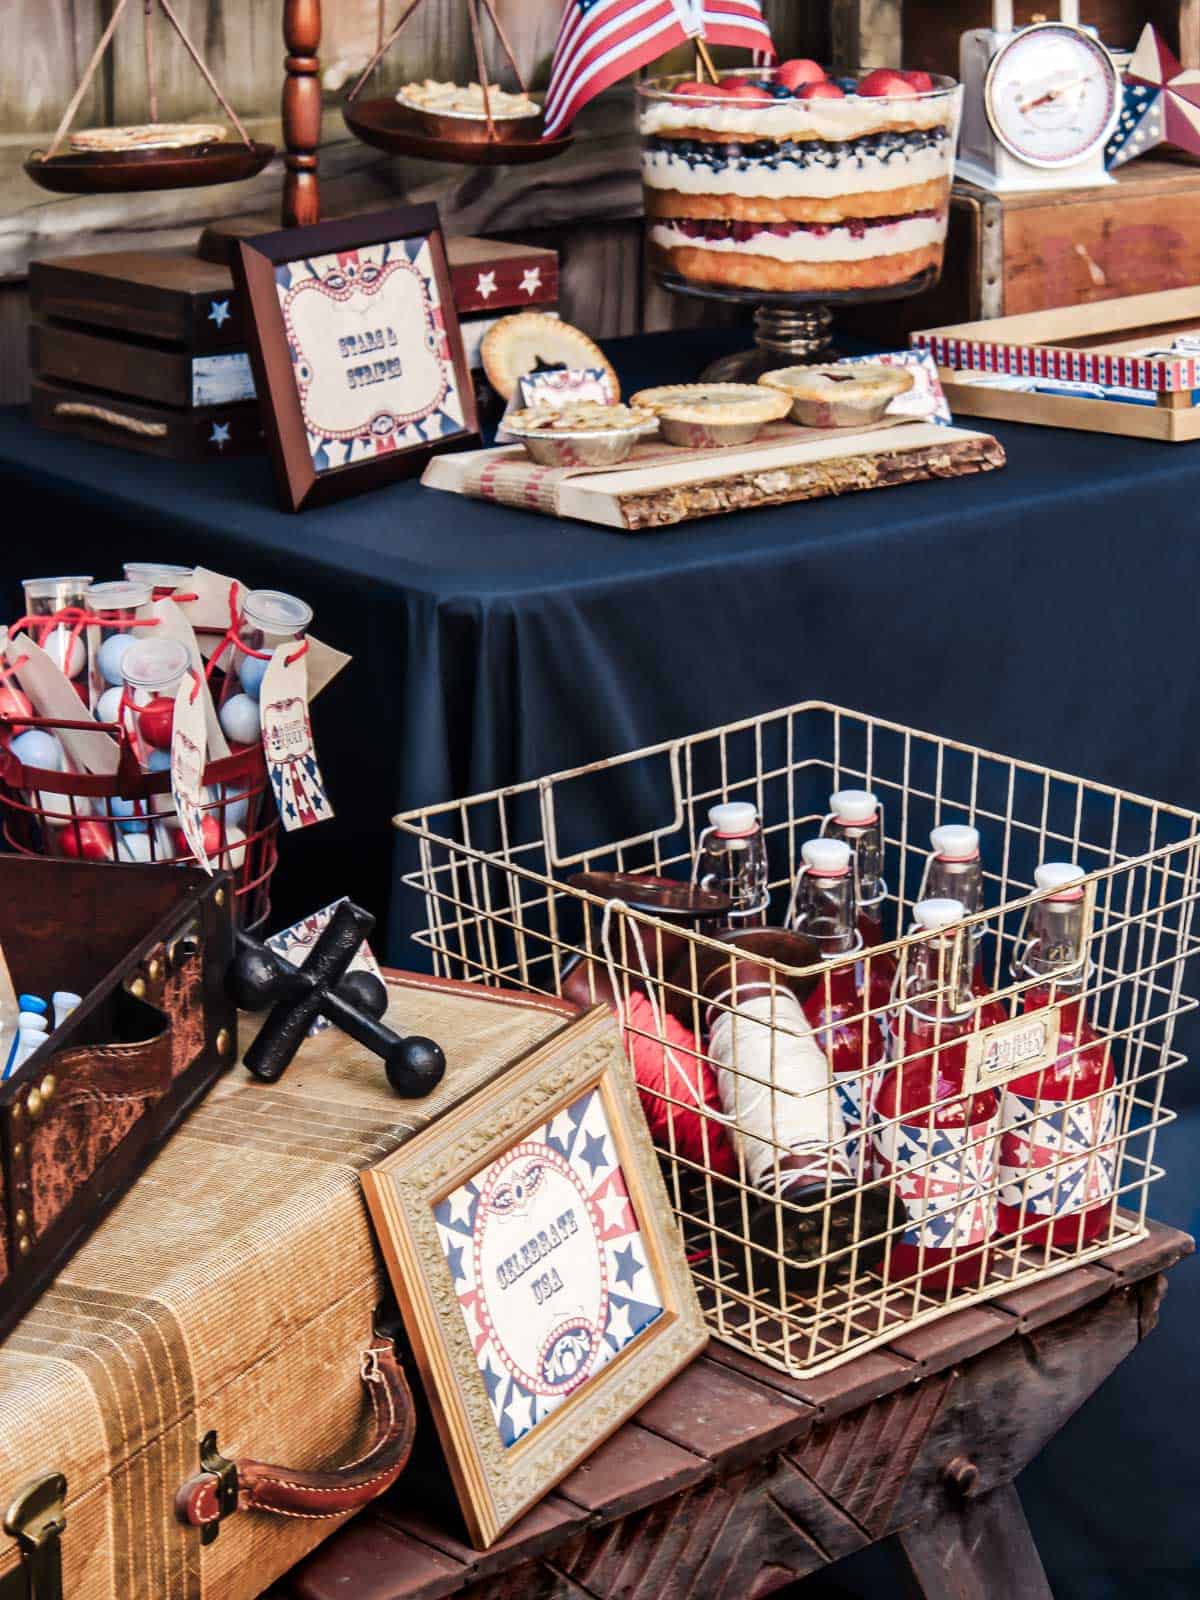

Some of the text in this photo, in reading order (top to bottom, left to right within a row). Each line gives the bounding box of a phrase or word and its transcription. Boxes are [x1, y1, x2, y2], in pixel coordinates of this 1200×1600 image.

[338, 328, 385, 358] STARS
[346, 356, 402, 389] STRIPES
[496, 1208, 578, 1290] CELEBRATE
[530, 1266, 564, 1306] USA
